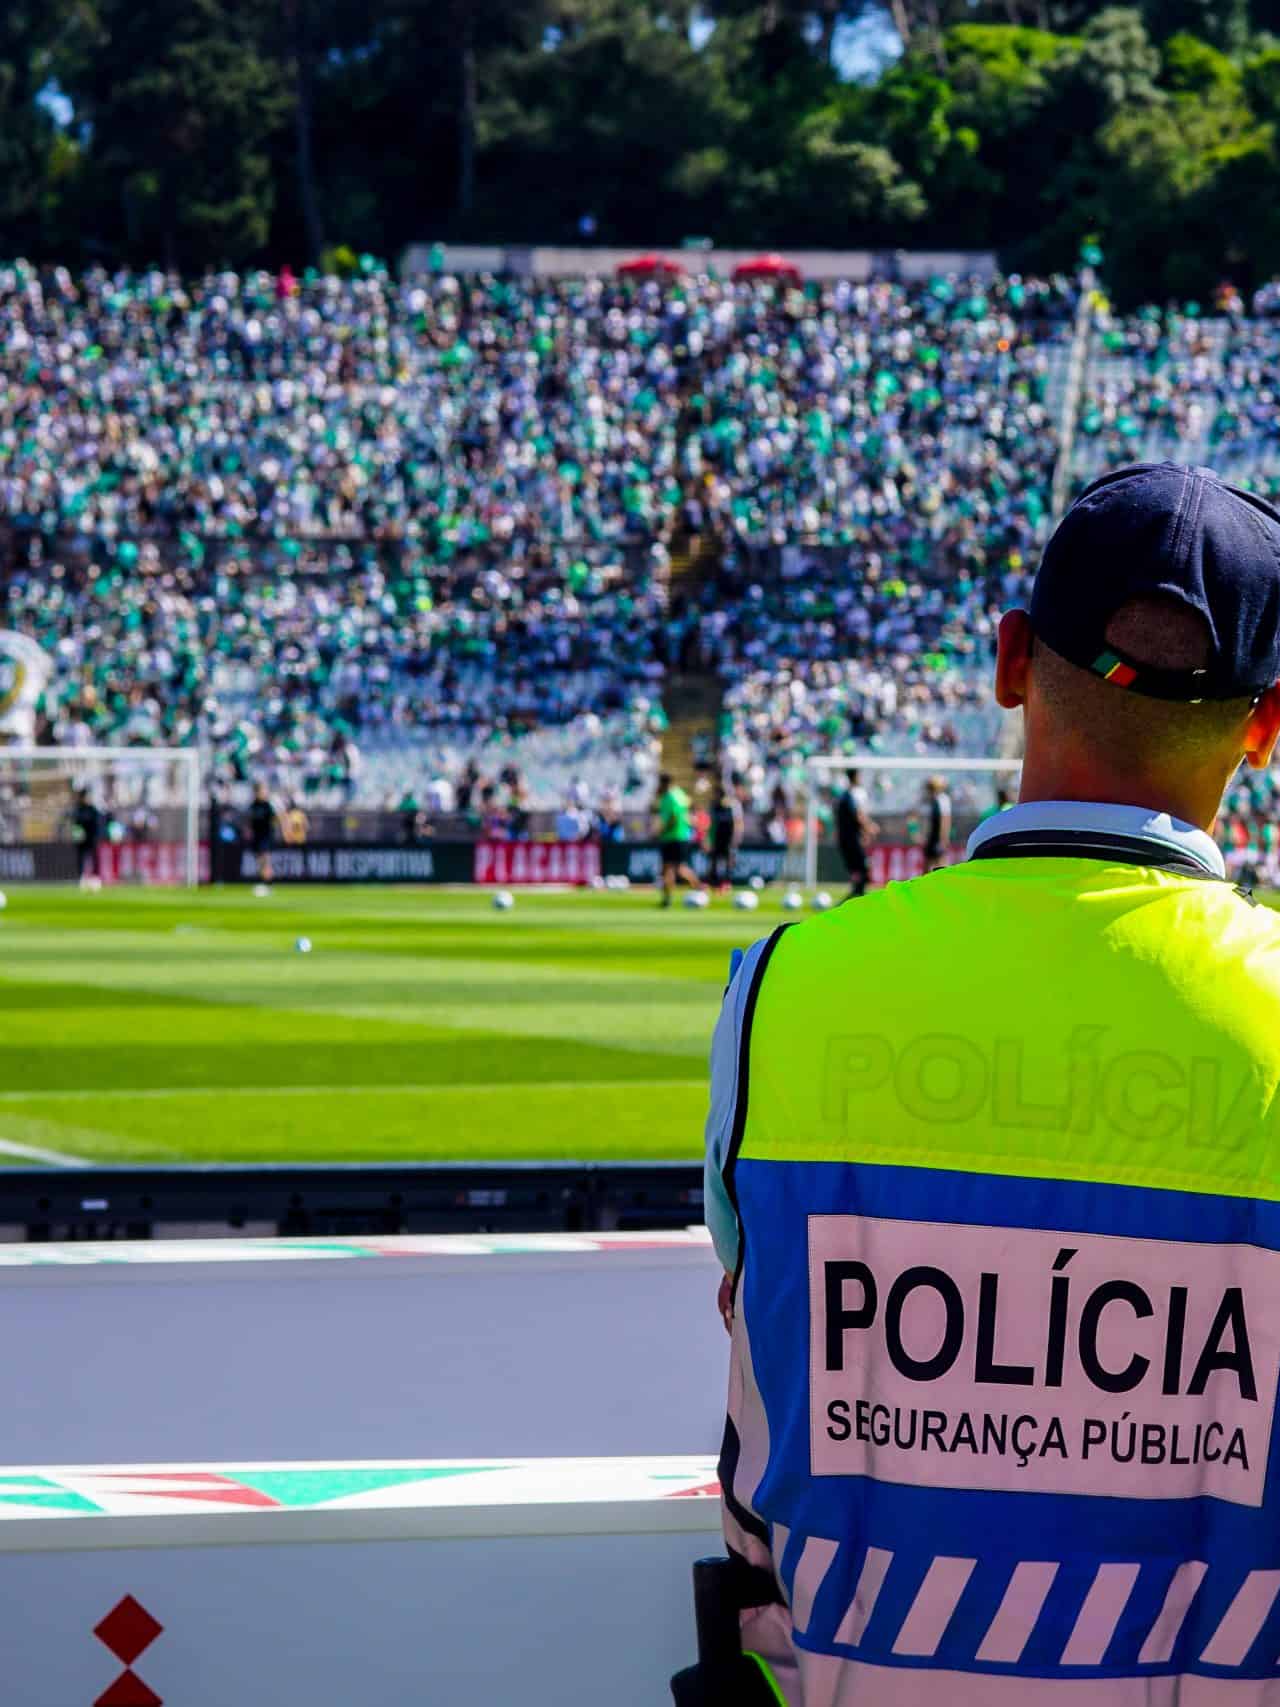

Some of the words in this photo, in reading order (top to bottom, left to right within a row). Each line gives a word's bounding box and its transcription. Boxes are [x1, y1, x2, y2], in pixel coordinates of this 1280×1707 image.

[824, 1248, 1258, 1402] POLÍCIA
[827, 1399, 1068, 1468] SEGURANÇA
[1082, 1411, 1250, 1470] PÚBLICA
